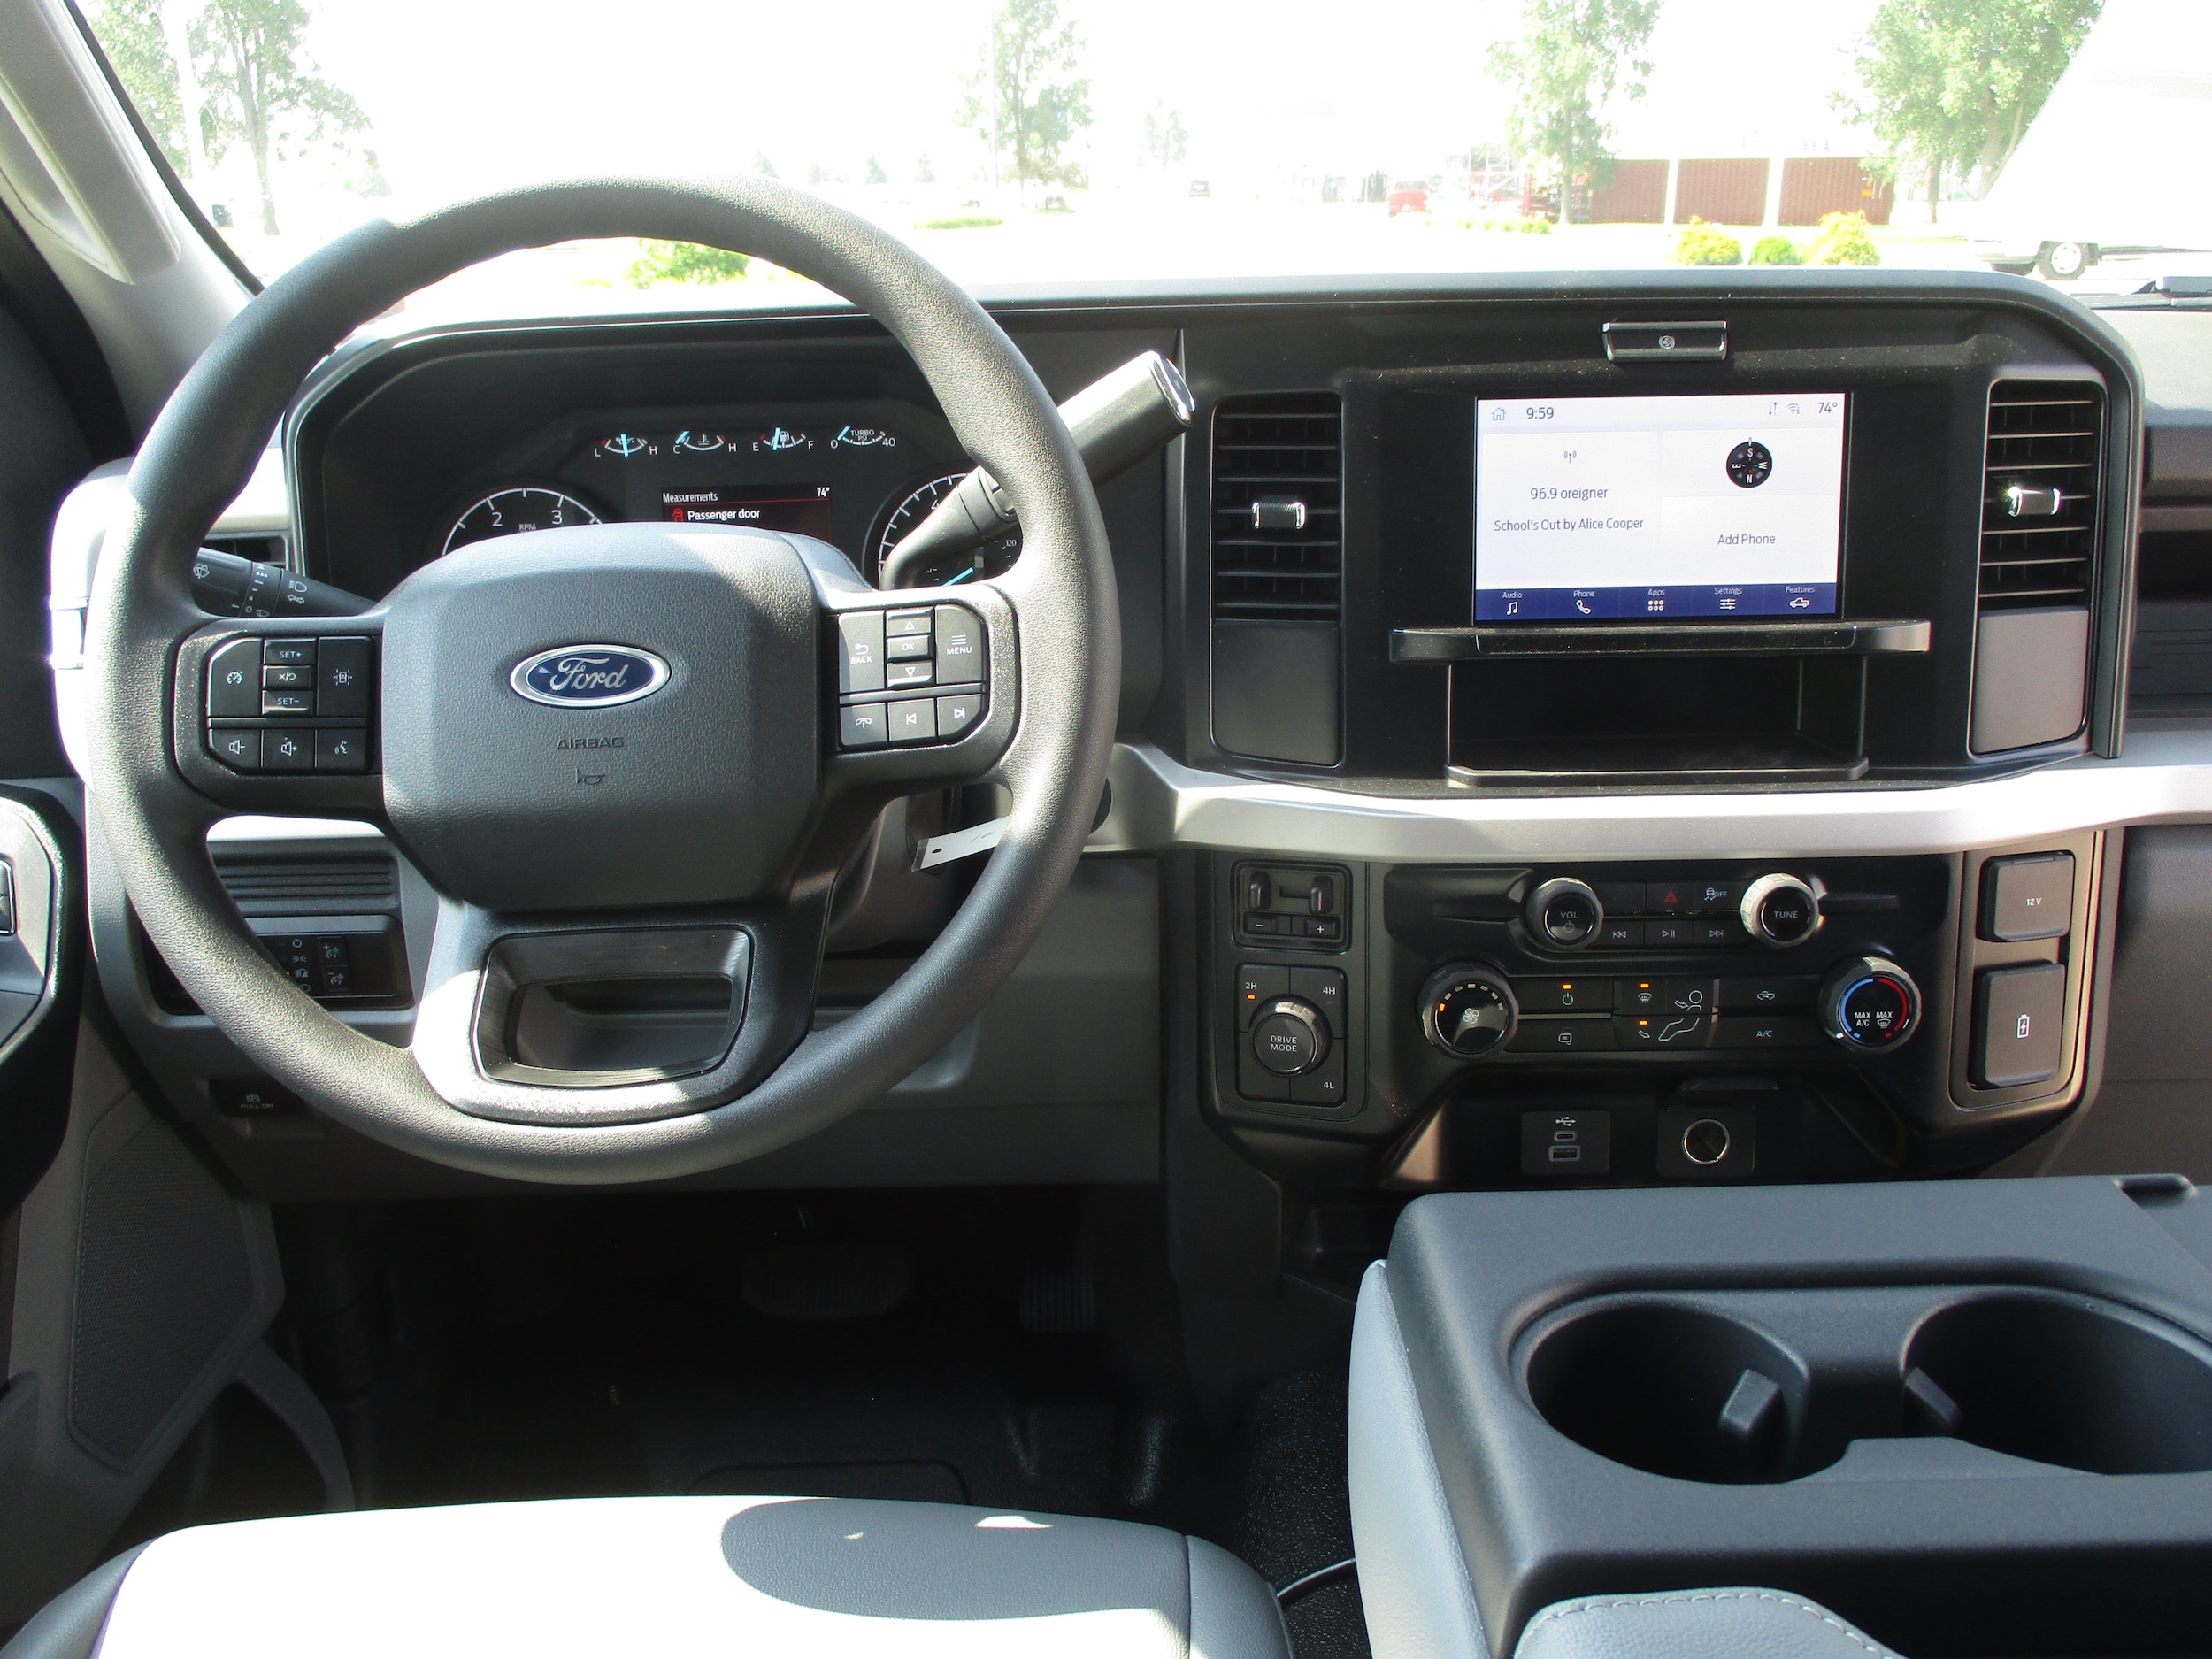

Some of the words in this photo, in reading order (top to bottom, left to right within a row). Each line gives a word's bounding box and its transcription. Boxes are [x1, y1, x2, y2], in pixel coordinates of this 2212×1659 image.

[1817, 401, 1838, 414] 74°
[1526, 407, 1555, 419] 9:59
[752, 442, 759, 452] E
[808, 441, 814, 449] F
[881, 438, 896, 447] 40
[649, 446, 657, 455] H
[672, 445, 680, 454] C
[728, 443, 737, 452] H
[1747, 447, 1754, 457] S
[594, 448, 601, 457] L
[1746, 474, 1753, 483] N
[816, 487, 830, 497] 74°
[1530, 488, 1557, 500] 96.9
[1560, 488, 1609, 501] oreigner
[663, 492, 718, 503] Measurements
[491, 511, 503, 527] 2
[551, 509, 563, 525] 3
[687, 509, 736, 522] Passenger
[738, 508, 761, 519] door
[518, 523, 536, 532] RPM
[1494, 519, 1539, 532] School's
[1540, 518, 1561, 531] Out
[1563, 518, 1577, 532] by
[1578, 518, 1604, 530] Alice
[1606, 518, 1644, 531] Cooper
[1717, 534, 1739, 545] Add
[1740, 534, 1776, 544] Phone
[1714, 587, 1743, 595] Settings
[946, 647, 972, 656] MENU
[850, 656, 872, 664] BACK
[549, 657, 629, 691] Ford
[556, 736, 625, 749] AIRBAG
[1773, 910, 1798, 919] TUNE
[1855, 1018, 1870, 1027] A/C
[1271, 1035, 1297, 1044] DRIVE
[1271, 1043, 1298, 1052] MODE
[1323, 1081, 1334, 1090] 4L
